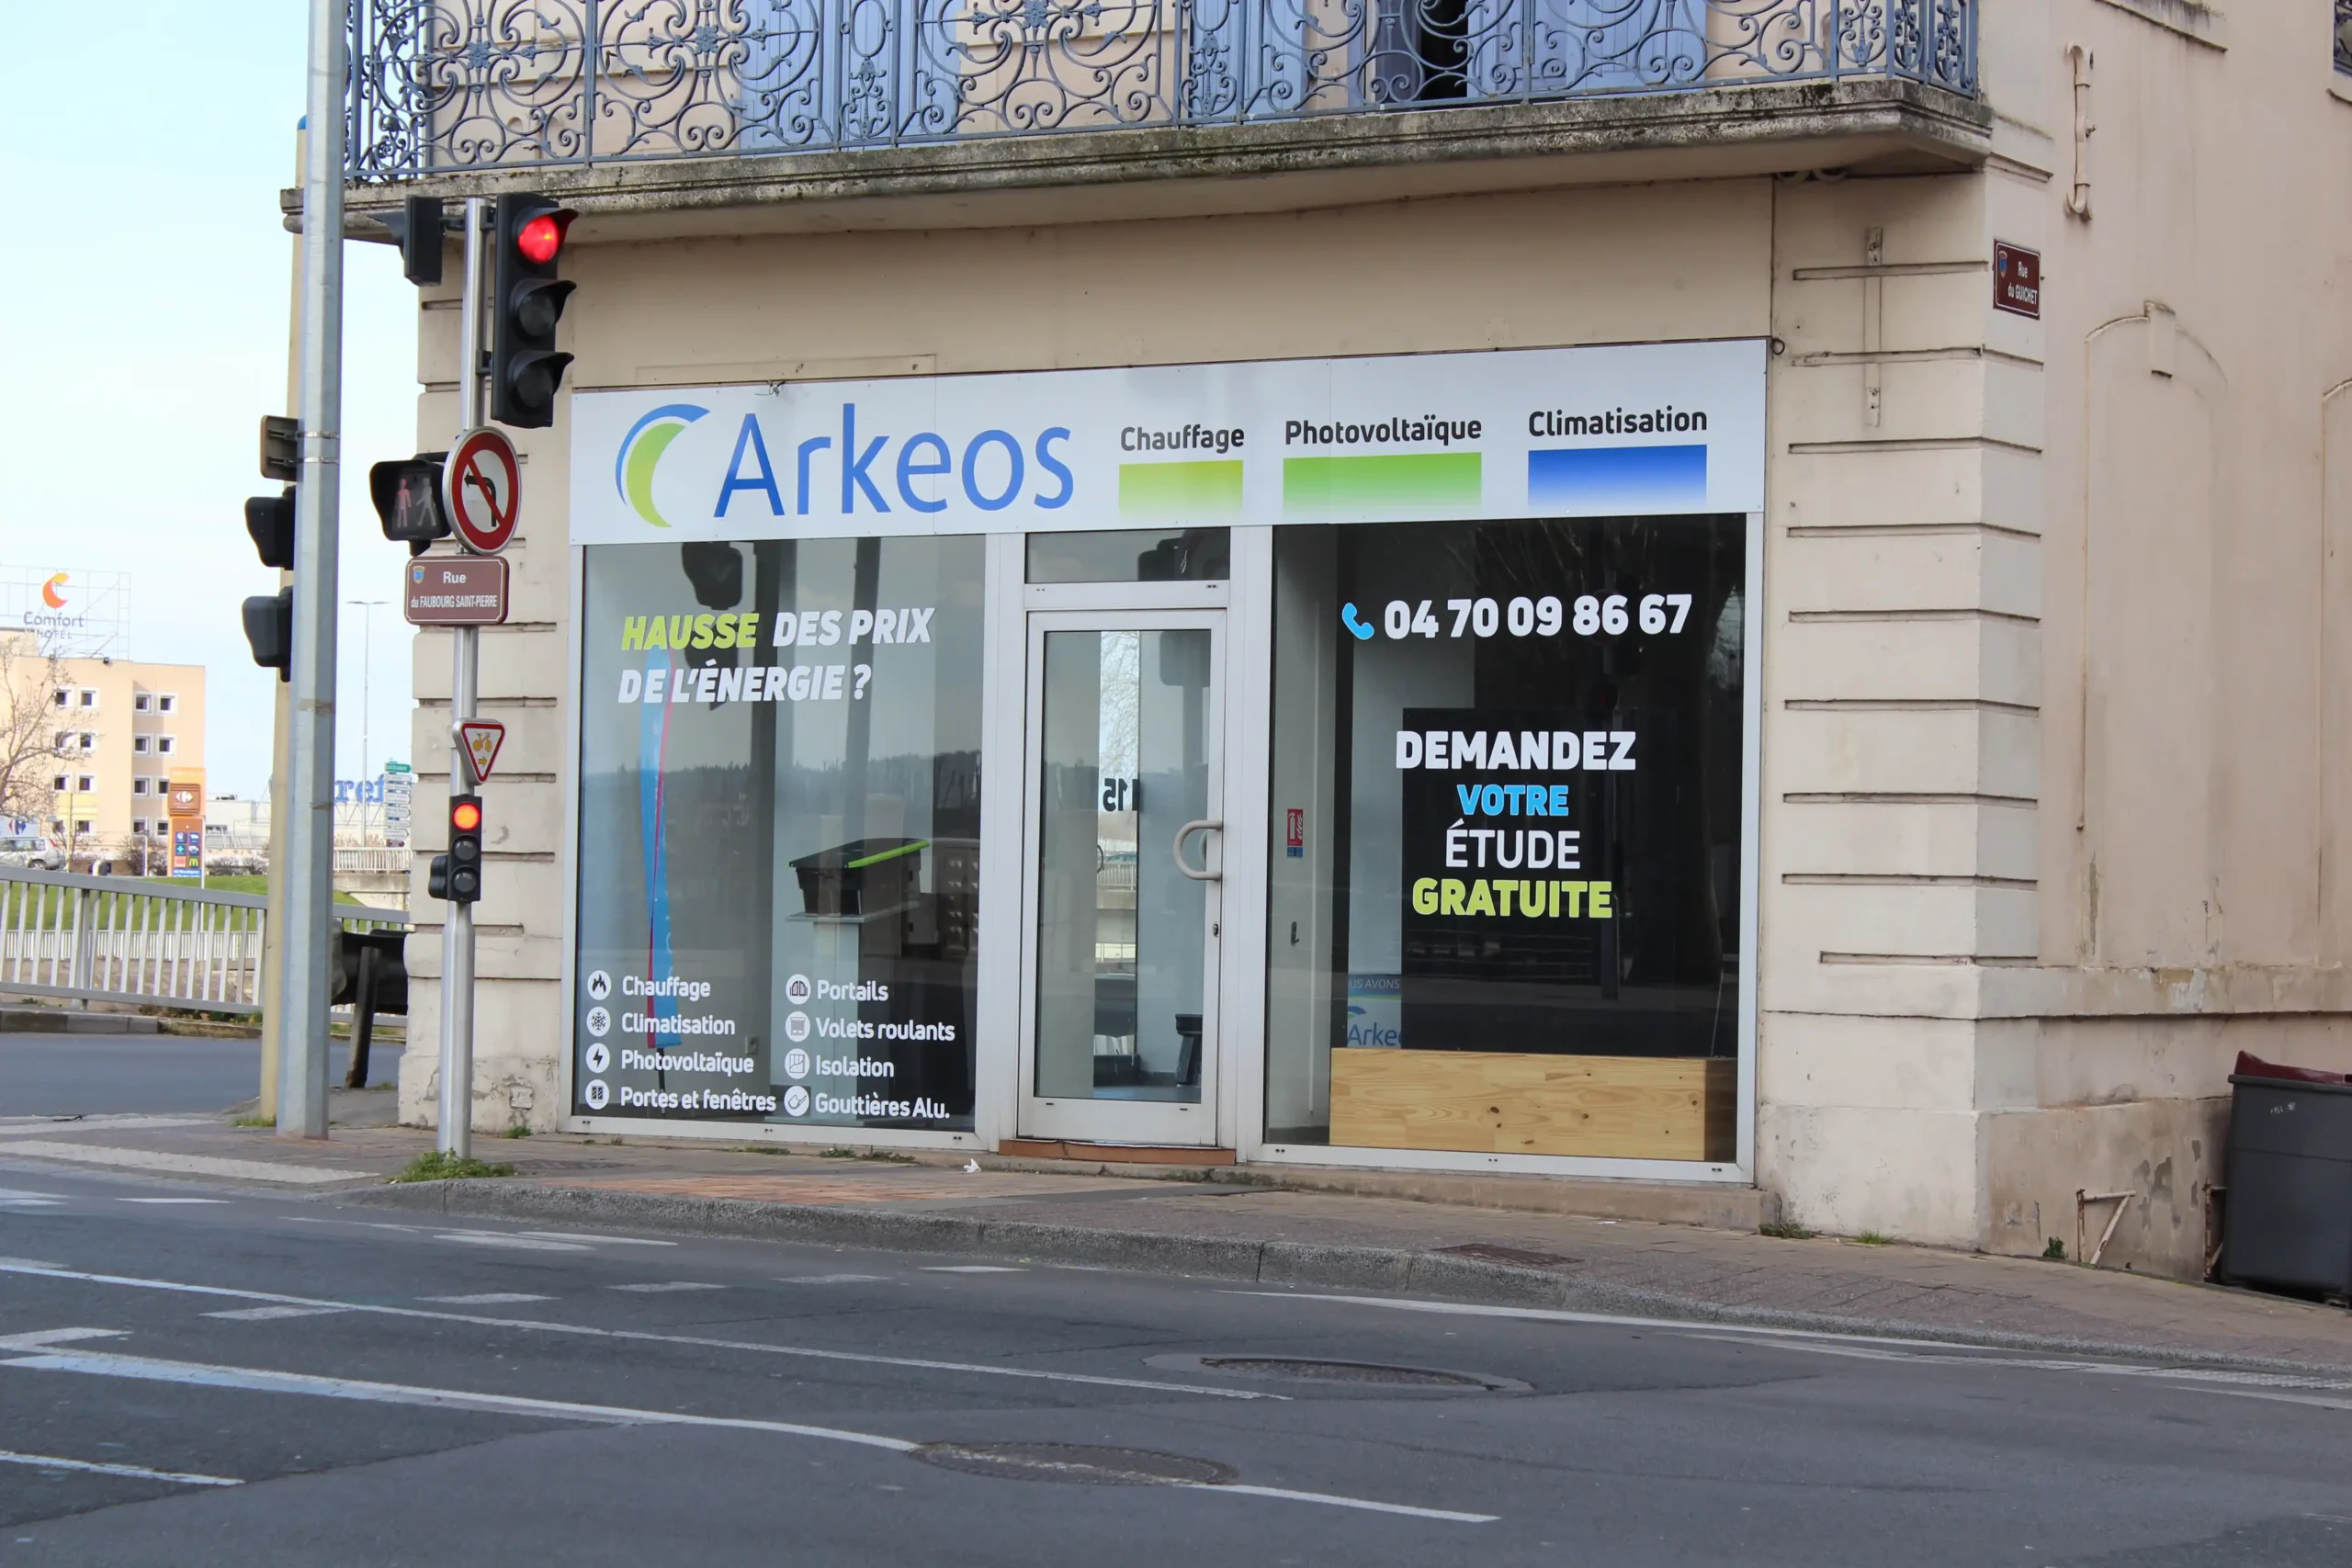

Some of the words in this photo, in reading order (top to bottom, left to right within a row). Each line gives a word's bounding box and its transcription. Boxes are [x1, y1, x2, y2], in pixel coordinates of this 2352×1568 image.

[2018, 261, 2028, 278] Rue
[2008, 282, 2014, 298] du
[2016, 285, 2038, 305] GUICHET
[1284, 414, 1482, 446] Photovoltaïque
[1528, 406, 1707, 437] Climatisation
[1120, 423, 1245, 454] Chauffage
[713, 402, 1074, 517] Arkeos
[443, 571, 467, 584] Rue
[411, 595, 419, 608] du
[419, 595, 455, 608] FAUBOURG
[456, 594, 497, 607] SAINT-PIERRE
[23, 612, 85, 628] Comfort
[621, 613, 760, 650] HAUSSE
[772, 610, 843, 647] DES
[848, 607, 935, 645] PRIX
[1384, 600, 1439, 639] 04
[1447, 598, 1498, 637] 70
[1507, 596, 1562, 637] 09
[1572, 594, 1628, 636] 86
[1639, 593, 1692, 635] 67
[617, 670, 667, 704] DE
[853, 663, 872, 699] ?
[1396, 730, 1636, 770] DEMANDEZ
[1457, 784, 1570, 817] VOTRE
[1446, 818, 1581, 870] ÉTUDE
[1412, 877, 1613, 919] GRATUITE
[621, 976, 711, 1001] Chauffage
[817, 979, 888, 1002] Portails
[1365, 978, 1400, 989] AVONS
[621, 1012, 736, 1036] Climatisation
[816, 1018, 875, 1039] Volets
[877, 1019, 956, 1042] roulants
[1347, 1021, 1402, 1047] Arke
[621, 1049, 754, 1077] Photovoltaïque
[815, 1055, 895, 1078] Isolation
[620, 1087, 679, 1109] Portes
[681, 1090, 700, 1110] et
[703, 1088, 776, 1112] fenêtres
[814, 1092, 910, 1118] Gouttières
[912, 1098, 951, 1119] Alu.
